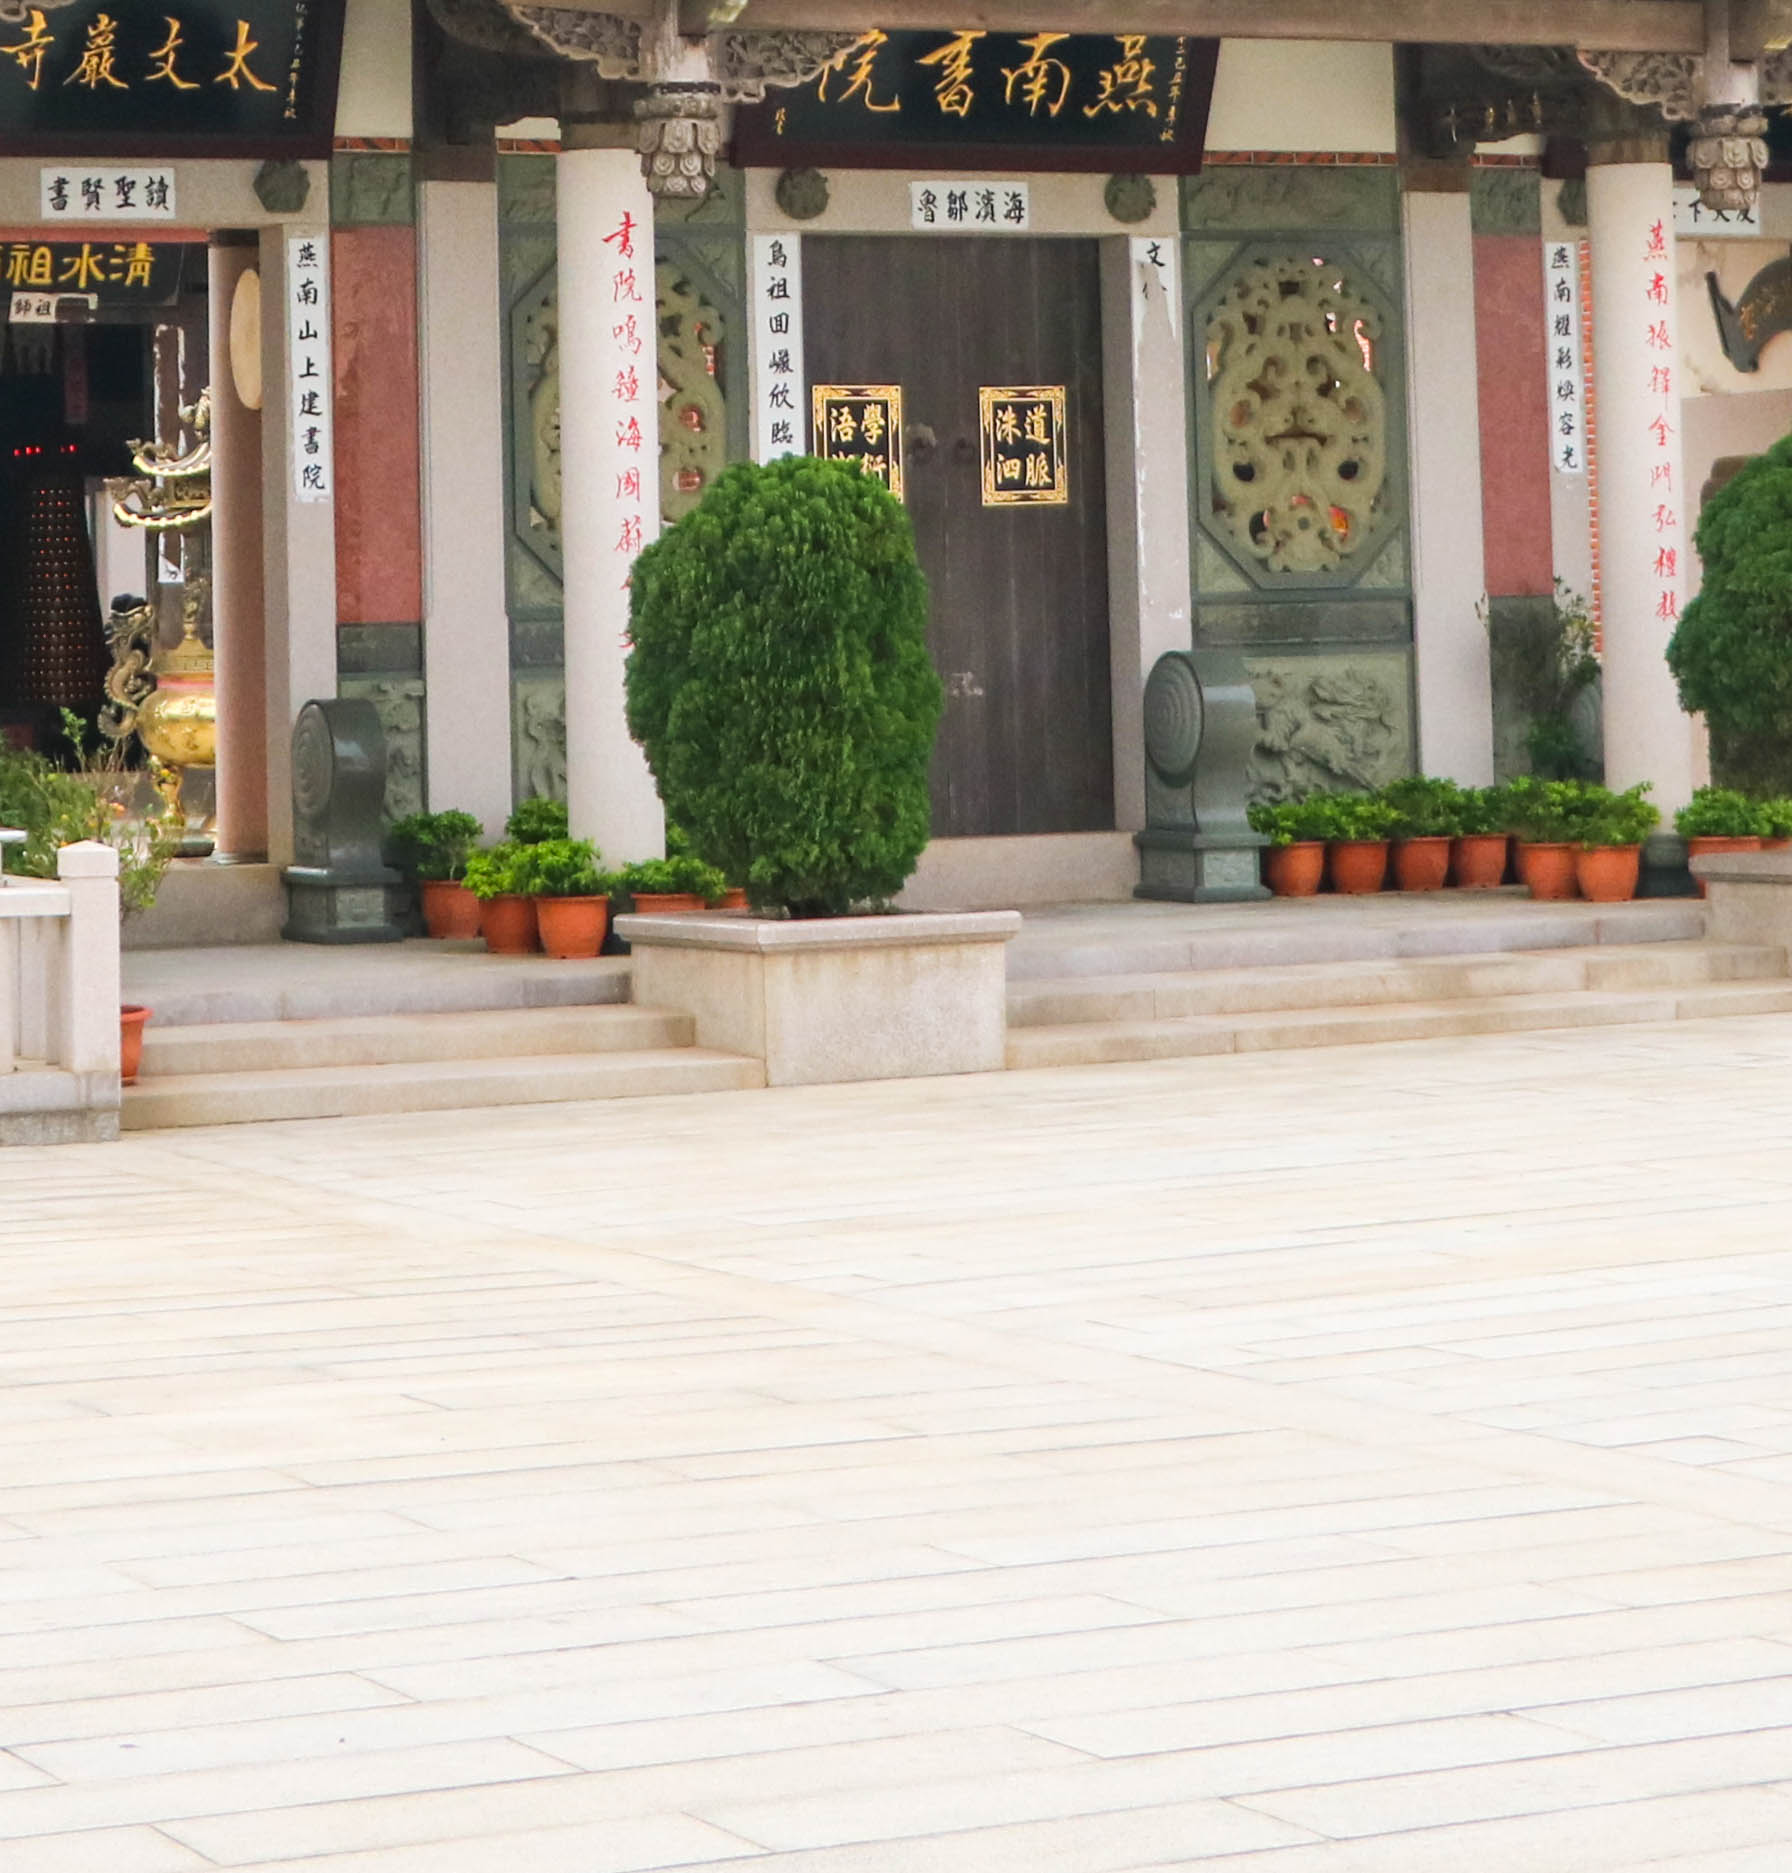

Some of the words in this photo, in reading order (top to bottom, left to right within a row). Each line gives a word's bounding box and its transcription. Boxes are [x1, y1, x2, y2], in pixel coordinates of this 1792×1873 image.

[47, 175, 169, 212] 讀聖賢書
[917, 187, 1026, 224] 海濱鄒魯
[295, 241, 326, 491] 燕南山上建書院
[829, 405, 857, 463] 浯
